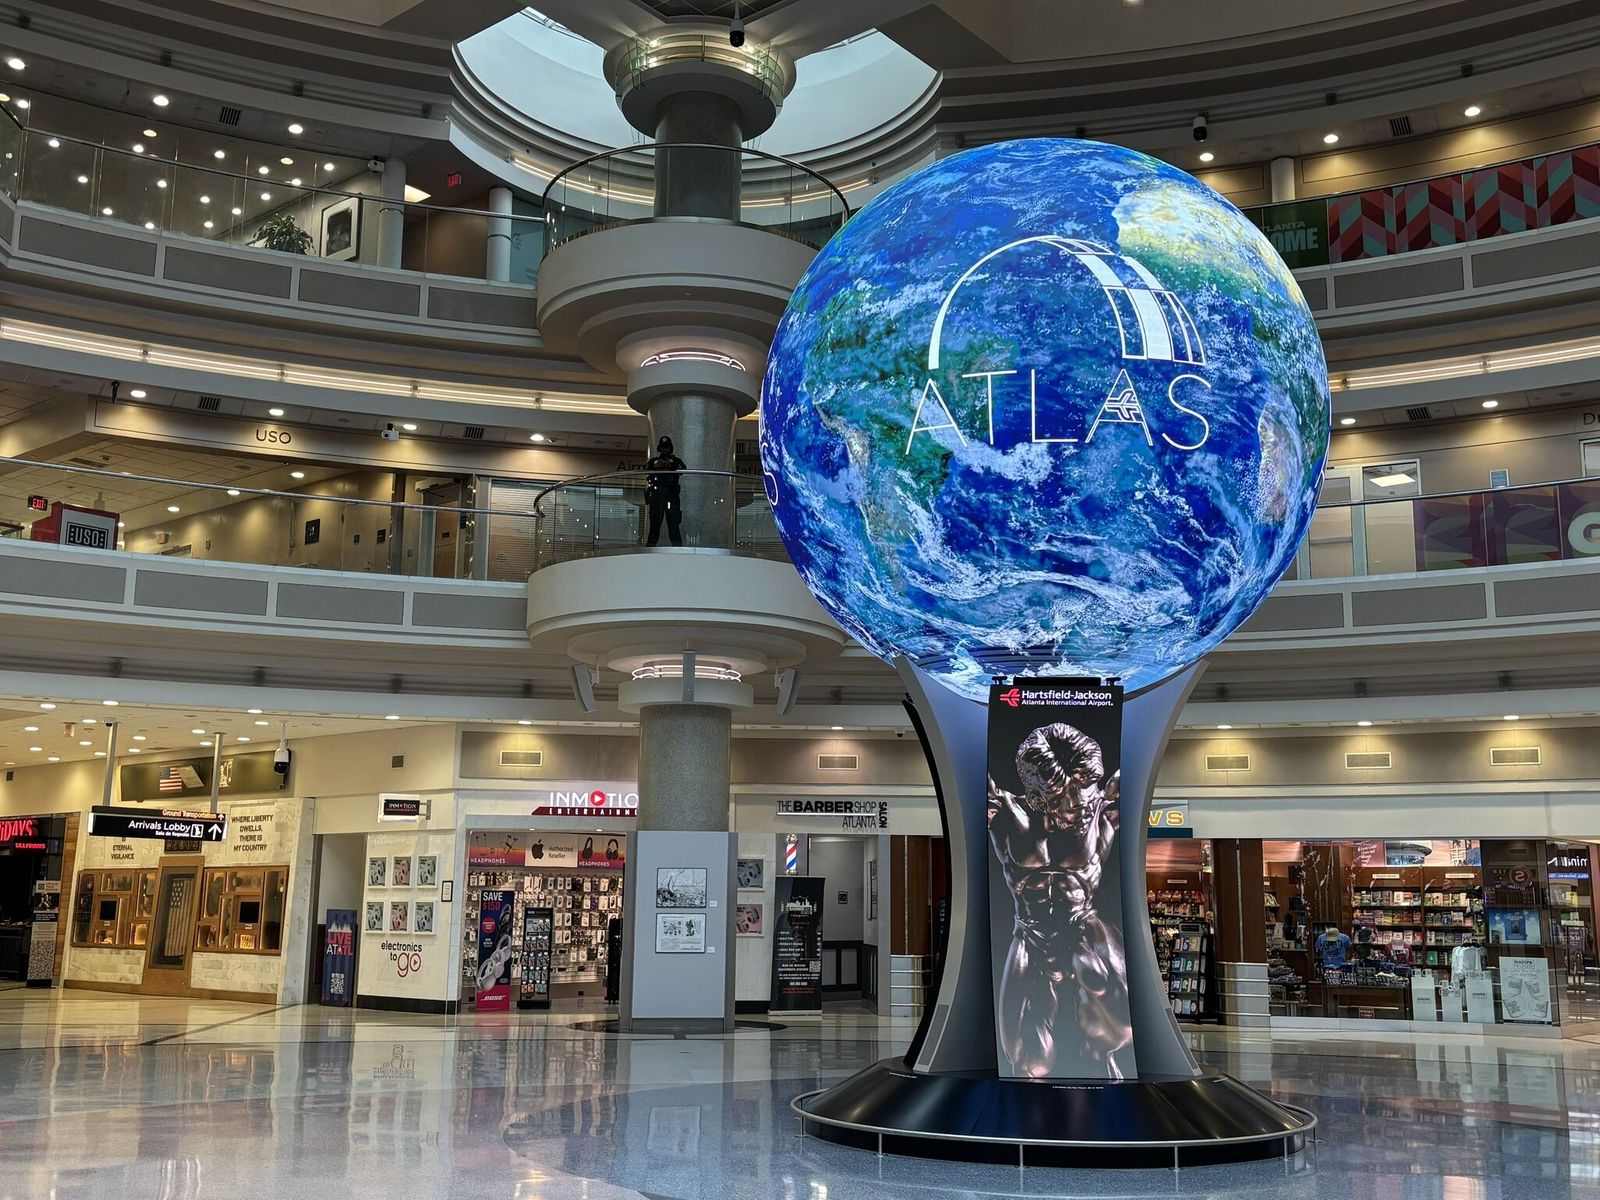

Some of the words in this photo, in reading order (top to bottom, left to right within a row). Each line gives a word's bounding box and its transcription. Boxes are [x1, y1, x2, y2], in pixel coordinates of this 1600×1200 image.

[905, 368, 1212, 455] ATLAS
[256, 429, 292, 444] USO
[32, 498, 44, 509] EXIT
[75, 527, 99, 547] USO
[1021, 690, 1112, 700] Hartsfield-Jackson
[161, 809, 182, 818] Ground
[182, 811, 217, 820] Transportation
[231, 815, 251, 823] WHERE
[251, 814, 273, 822] LIBERTY
[878, 801, 888, 828] SALON
[128, 820, 162, 830] Arrivals
[163, 822, 191, 833] Lobby
[842, 815, 877, 829] ATLANTA
[239, 834, 257, 842] THERE
[257, 834, 263, 842] IS
[233, 844, 241, 852] MY
[241, 843, 267, 852] COUNTRY
[548, 845, 574, 853] Authorized
[482, 891, 503, 901] SAVE
[482, 901, 501, 911] $150
[327, 931, 352, 945] LIVE
[381, 940, 422, 952] electronics
[390, 951, 398, 961] to
[397, 952, 422, 978] go
